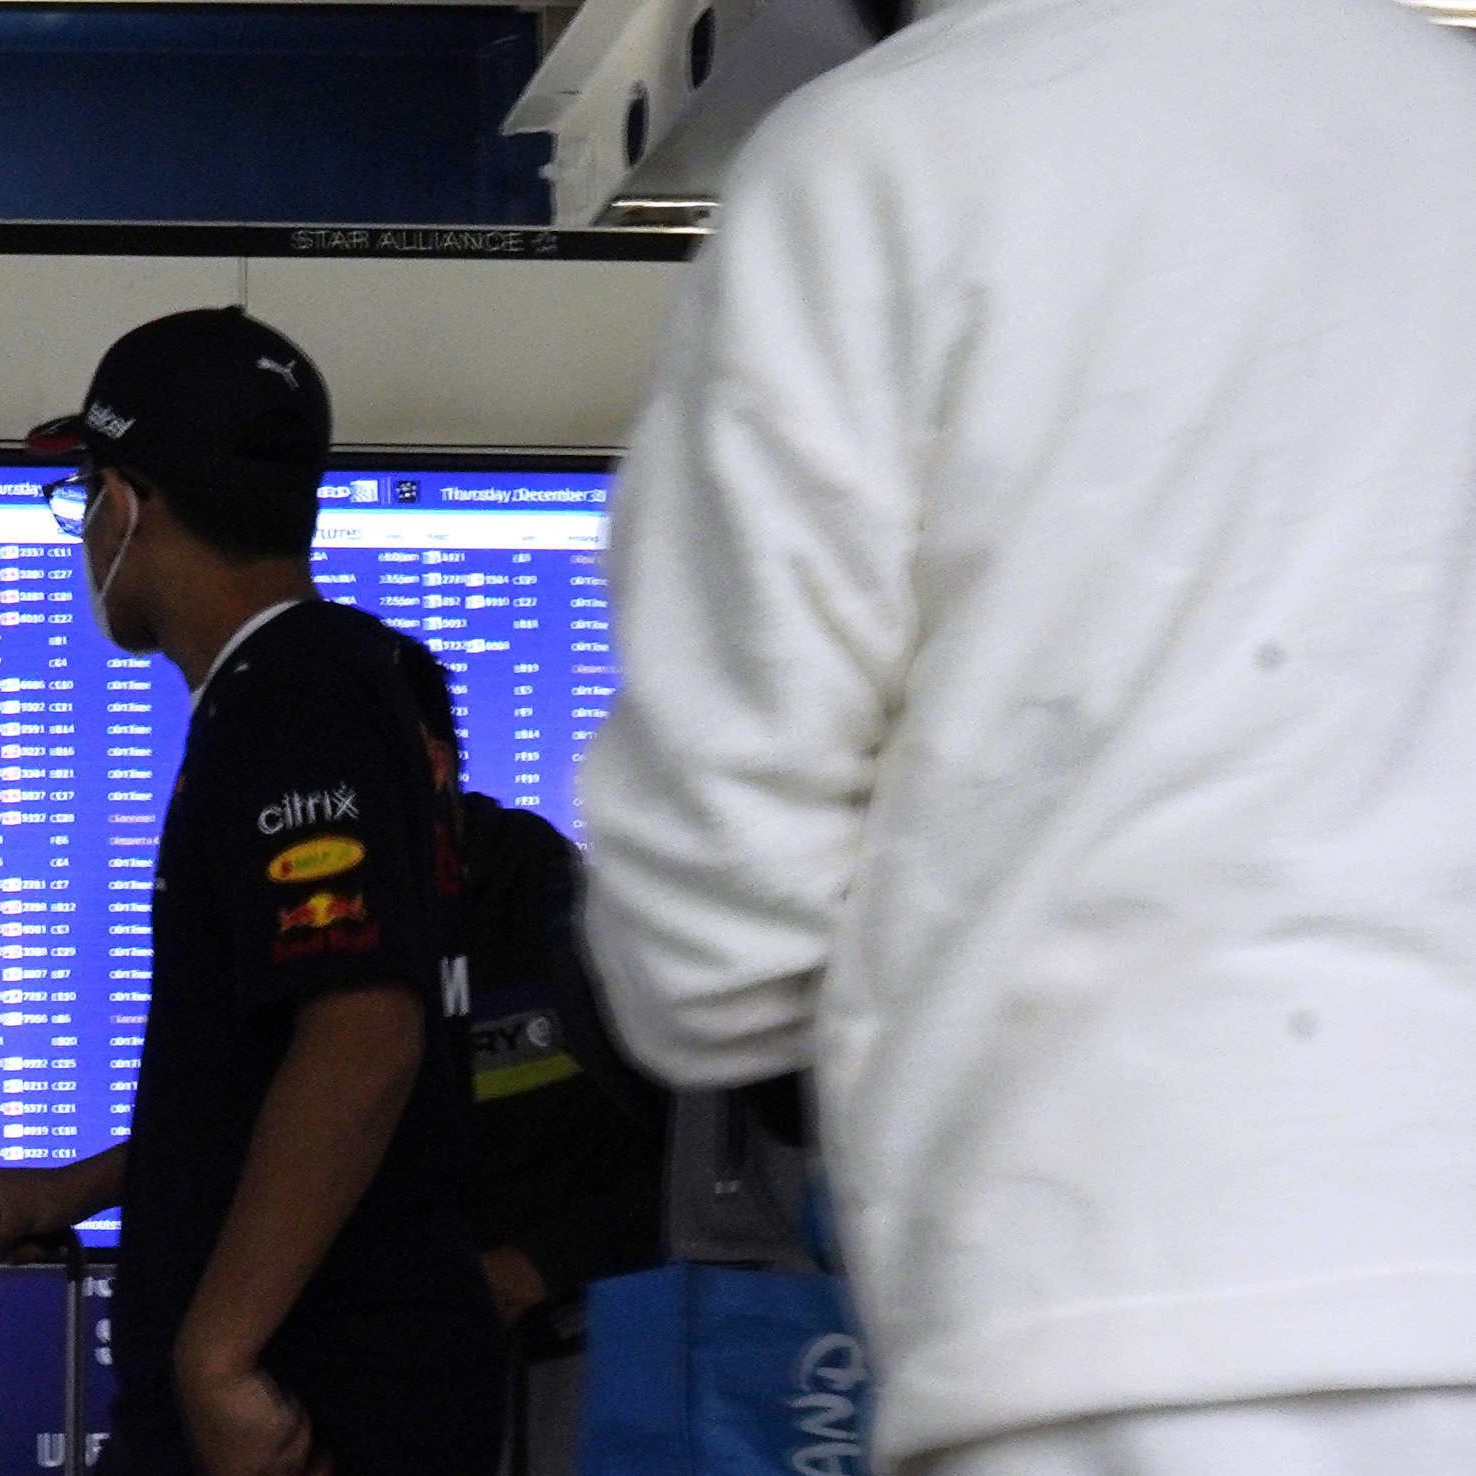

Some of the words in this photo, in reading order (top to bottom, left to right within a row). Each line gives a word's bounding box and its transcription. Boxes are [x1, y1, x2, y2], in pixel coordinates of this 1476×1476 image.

[293, 230, 367, 252] STAR
[377, 230, 522, 252] ALLIANCE
[512, 489, 586, 503] December
[257, 781, 361, 836] citrix
